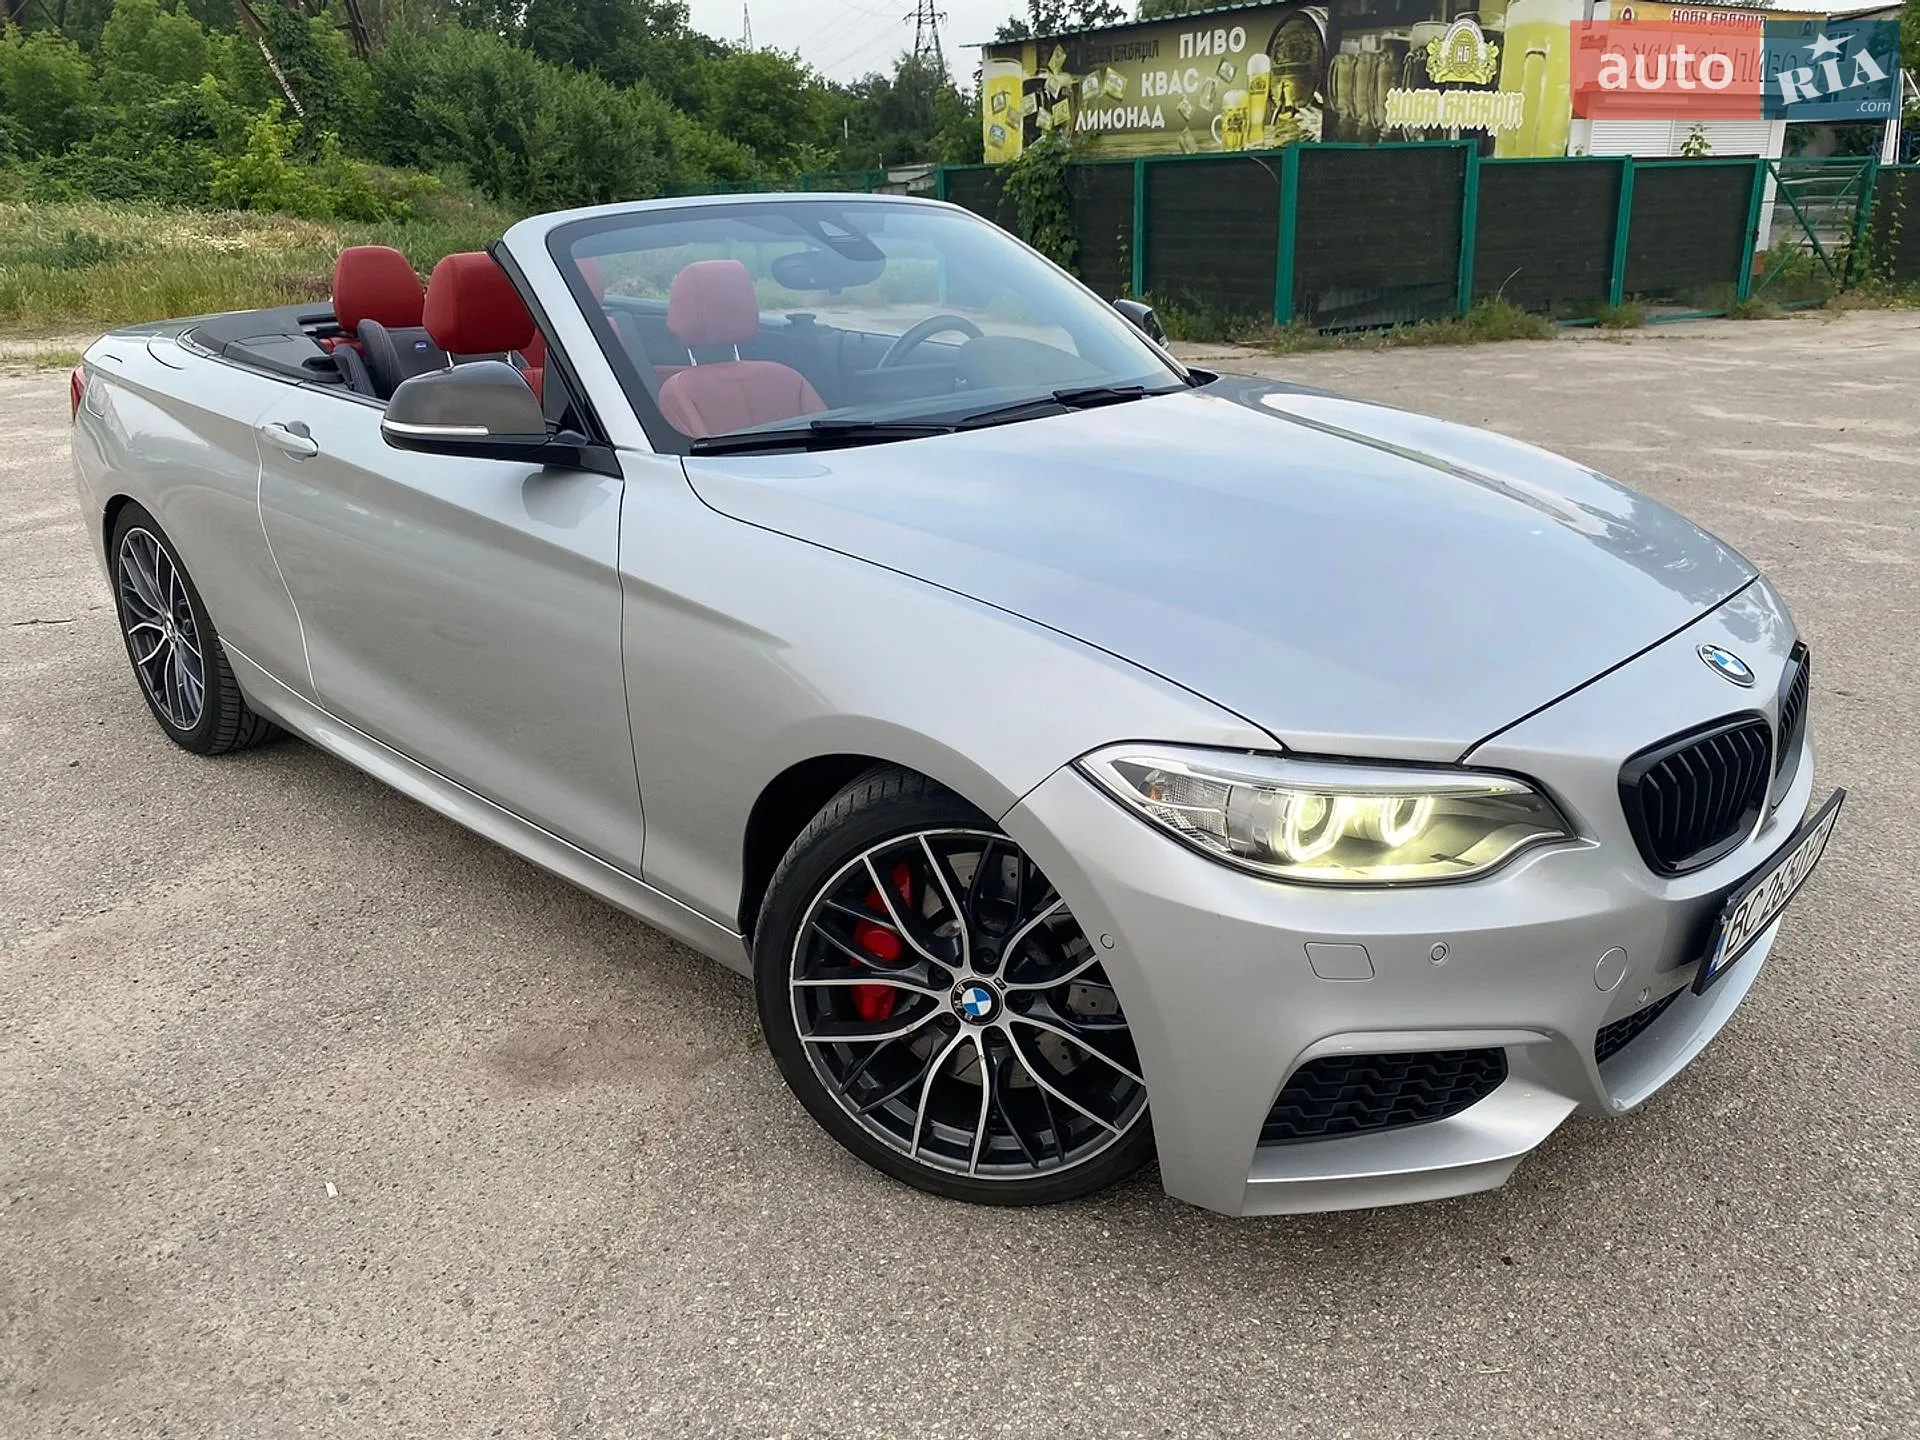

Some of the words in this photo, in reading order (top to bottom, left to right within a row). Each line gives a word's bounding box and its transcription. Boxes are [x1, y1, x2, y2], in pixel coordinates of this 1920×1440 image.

[1671, 9, 1708, 25] НОВА
[1179, 26, 1247, 59] ПИВО
[1140, 67, 1199, 97] КВАС
[1074, 104, 1166, 132] ЛИМОНАД
